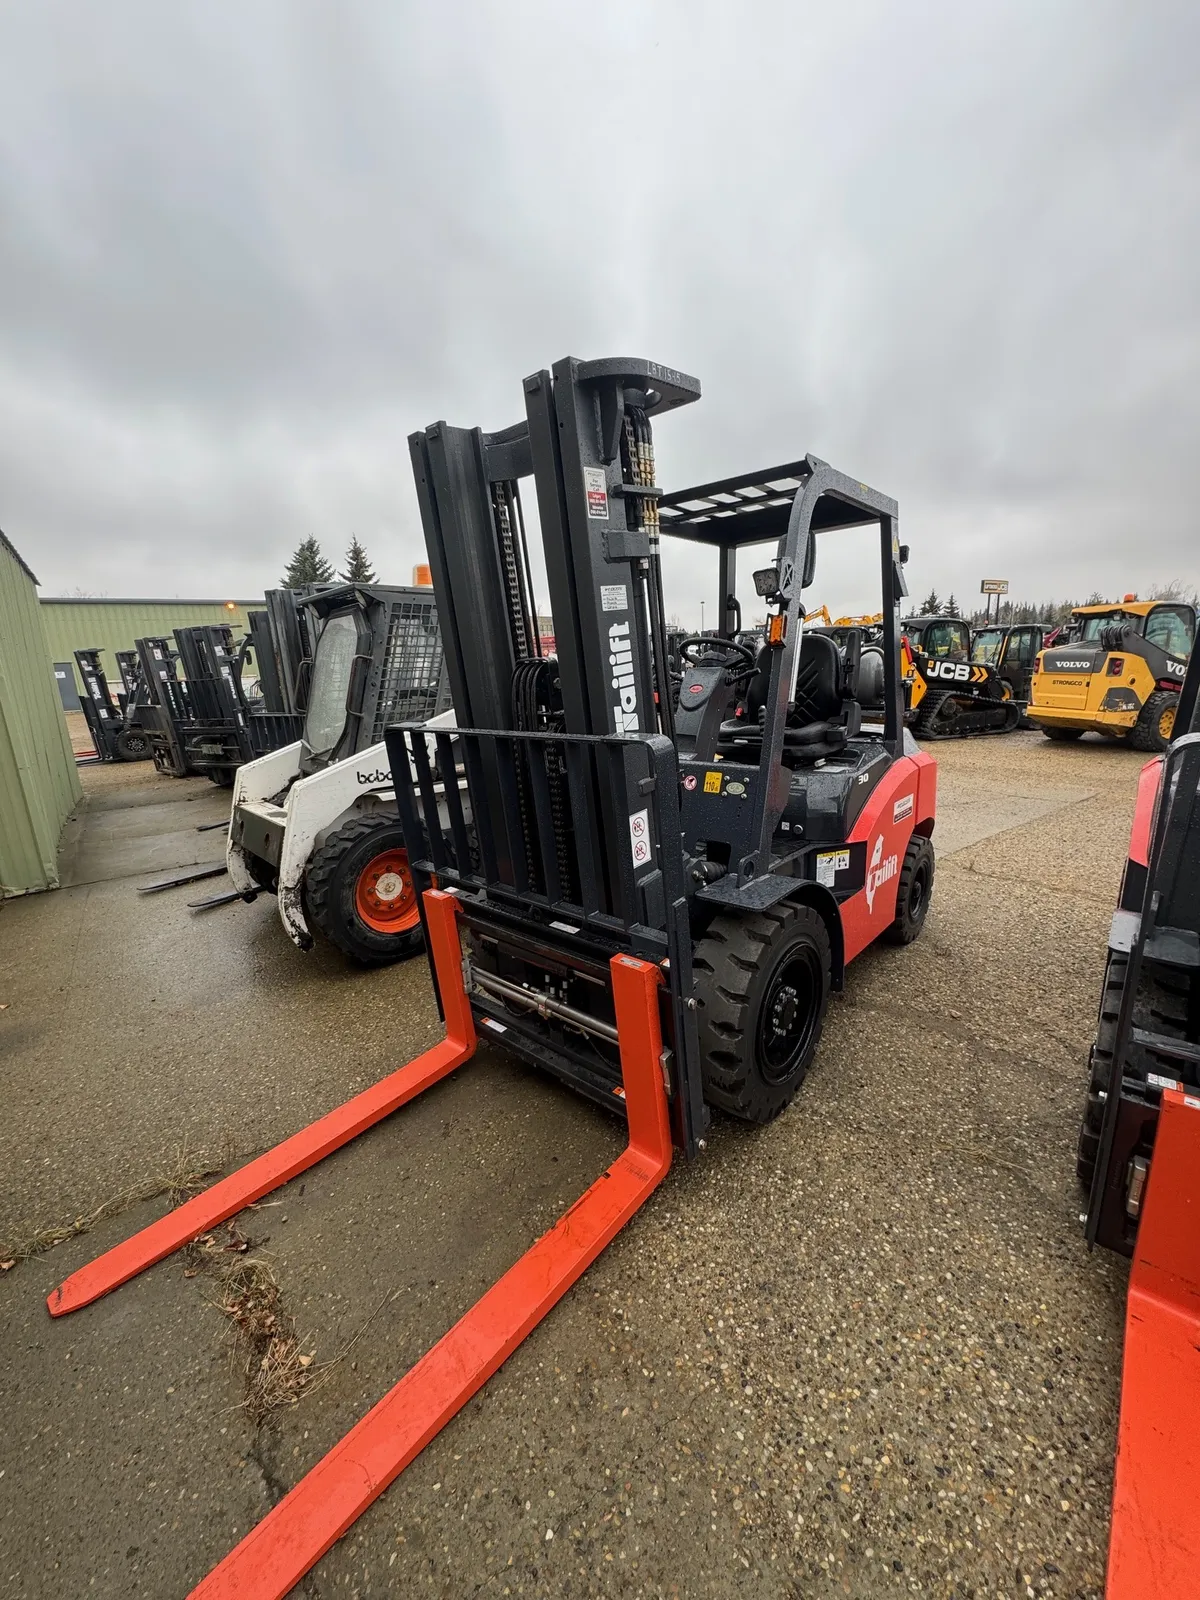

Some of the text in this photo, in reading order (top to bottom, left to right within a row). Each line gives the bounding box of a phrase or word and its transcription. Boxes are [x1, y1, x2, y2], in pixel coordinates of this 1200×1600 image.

[926, 660, 971, 681] JCB
[1165, 660, 1188, 678] VO
[858, 773, 869, 785] 30
